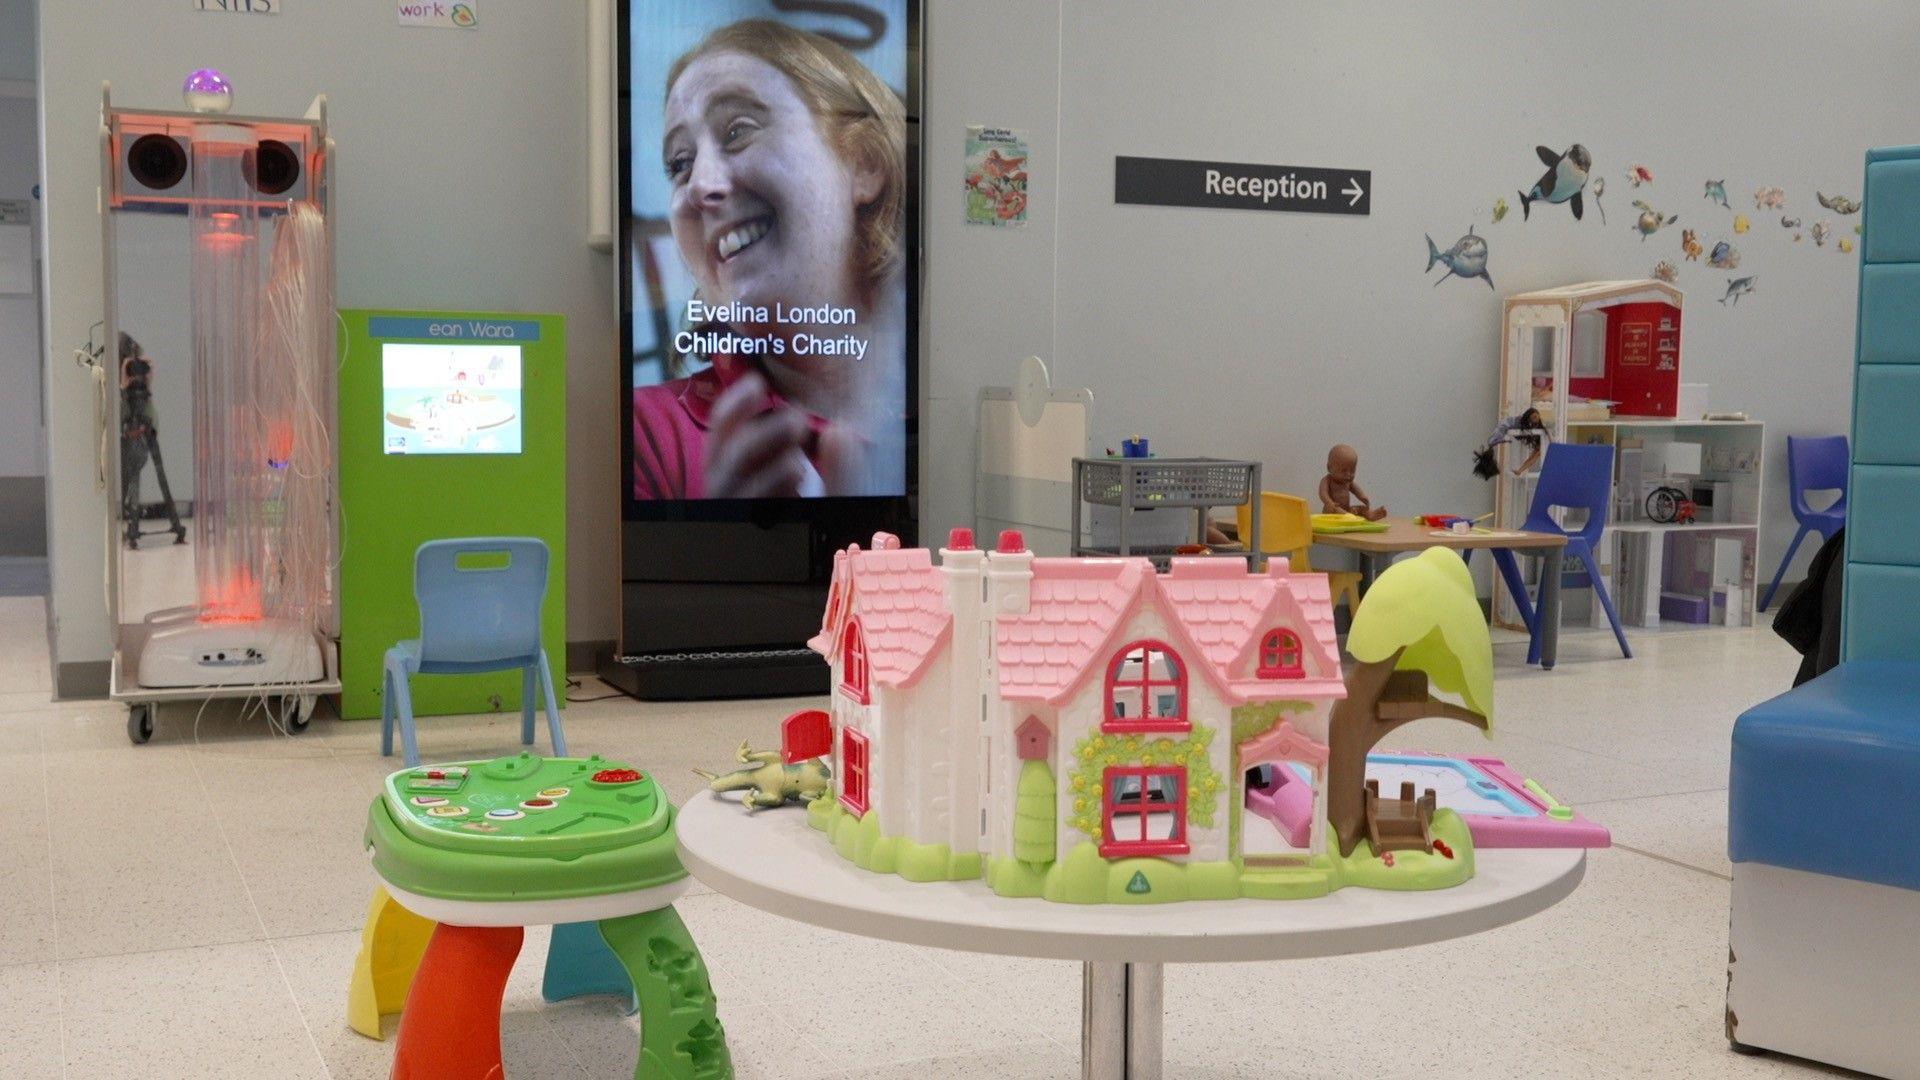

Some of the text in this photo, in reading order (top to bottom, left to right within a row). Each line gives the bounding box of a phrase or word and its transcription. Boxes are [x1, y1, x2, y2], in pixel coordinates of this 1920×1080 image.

[399, 2, 446, 16] work
[1205, 169, 1328, 203] Reception
[687, 300, 856, 324] Evelina London
[429, 323, 462, 336] ean
[674, 331, 868, 360] Children's Charity
